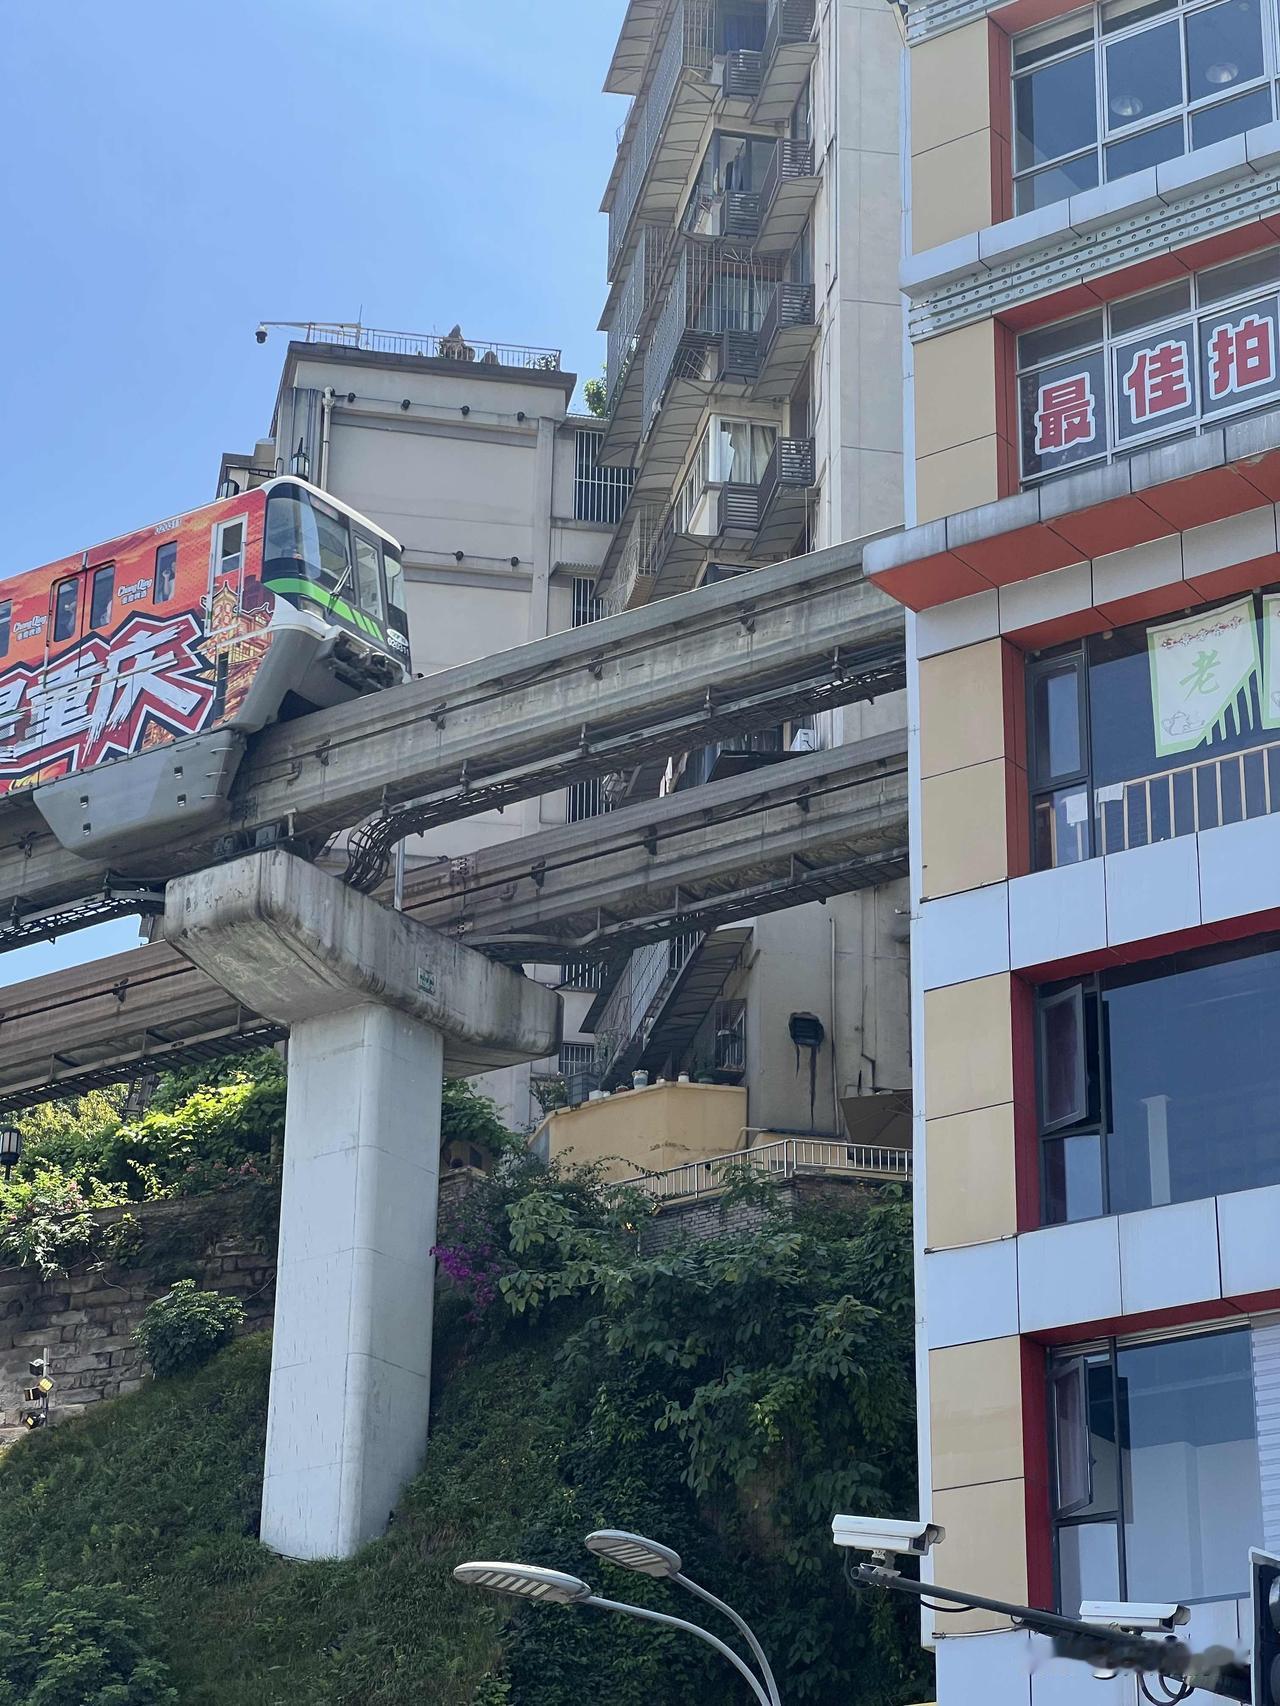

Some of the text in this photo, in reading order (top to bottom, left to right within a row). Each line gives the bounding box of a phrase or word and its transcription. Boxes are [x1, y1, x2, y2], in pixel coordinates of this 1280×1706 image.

[1034, 313, 1273, 455] 最佳拍
[1178, 649, 1221, 701] 老
